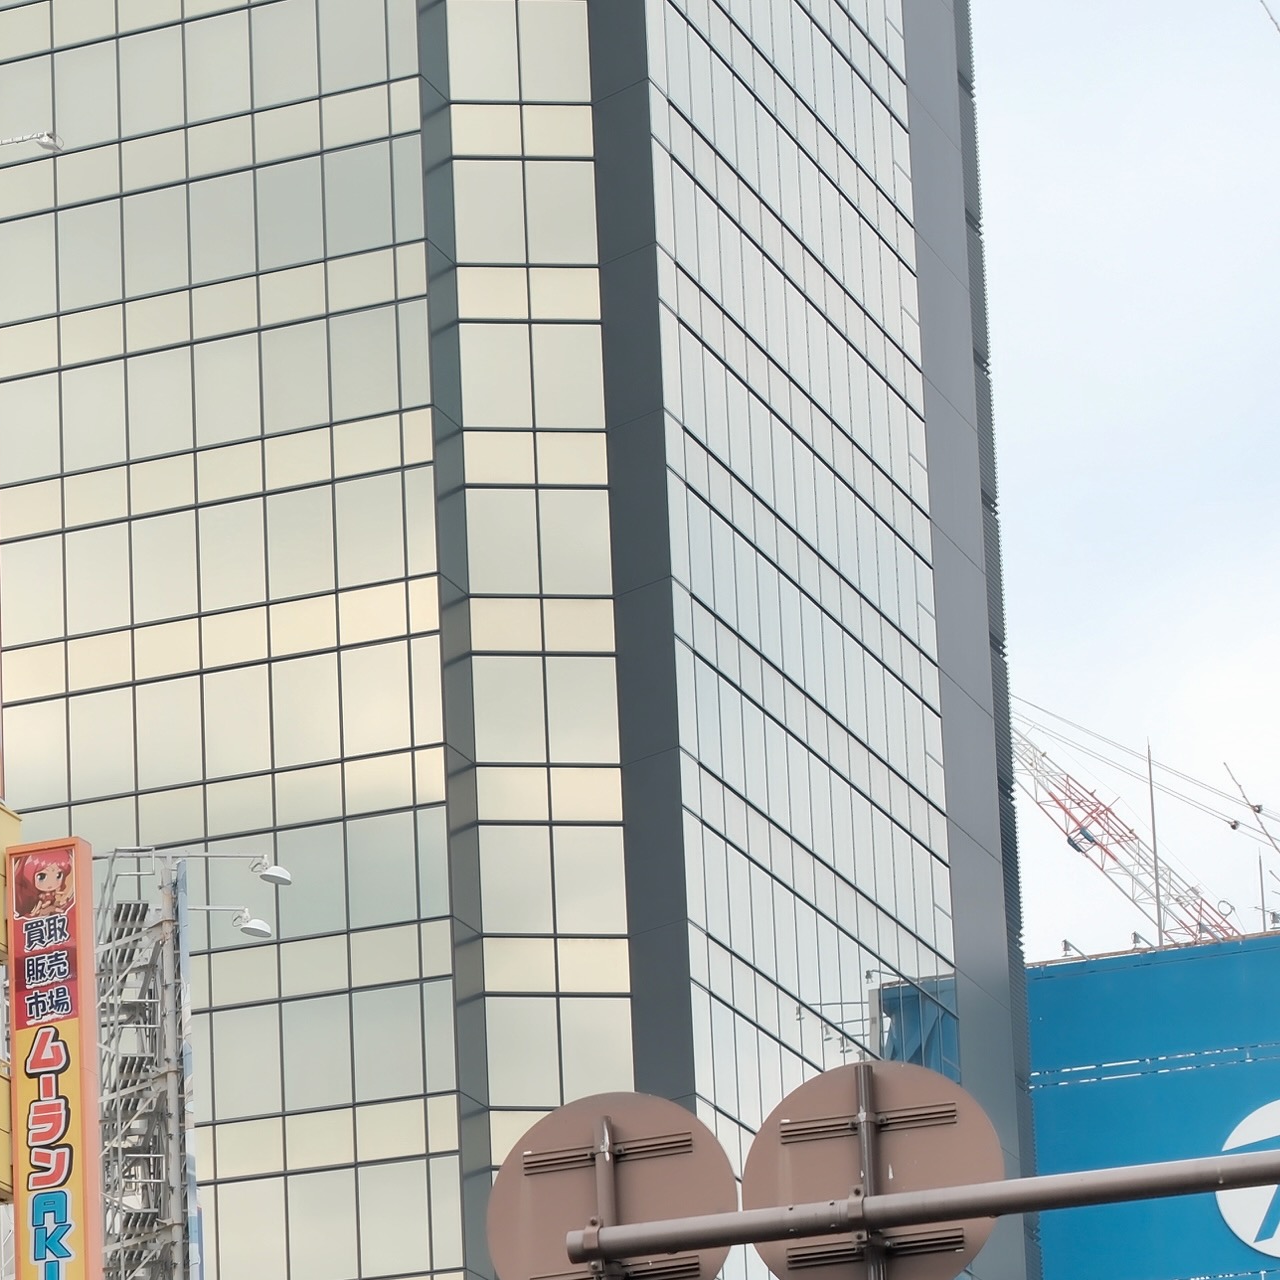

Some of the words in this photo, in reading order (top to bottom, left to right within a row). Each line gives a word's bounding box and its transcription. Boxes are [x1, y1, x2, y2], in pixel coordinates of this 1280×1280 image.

[24, 916, 70, 952] 買取
[25, 951, 69, 987] 販売
[26, 987, 72, 1021] 市場
